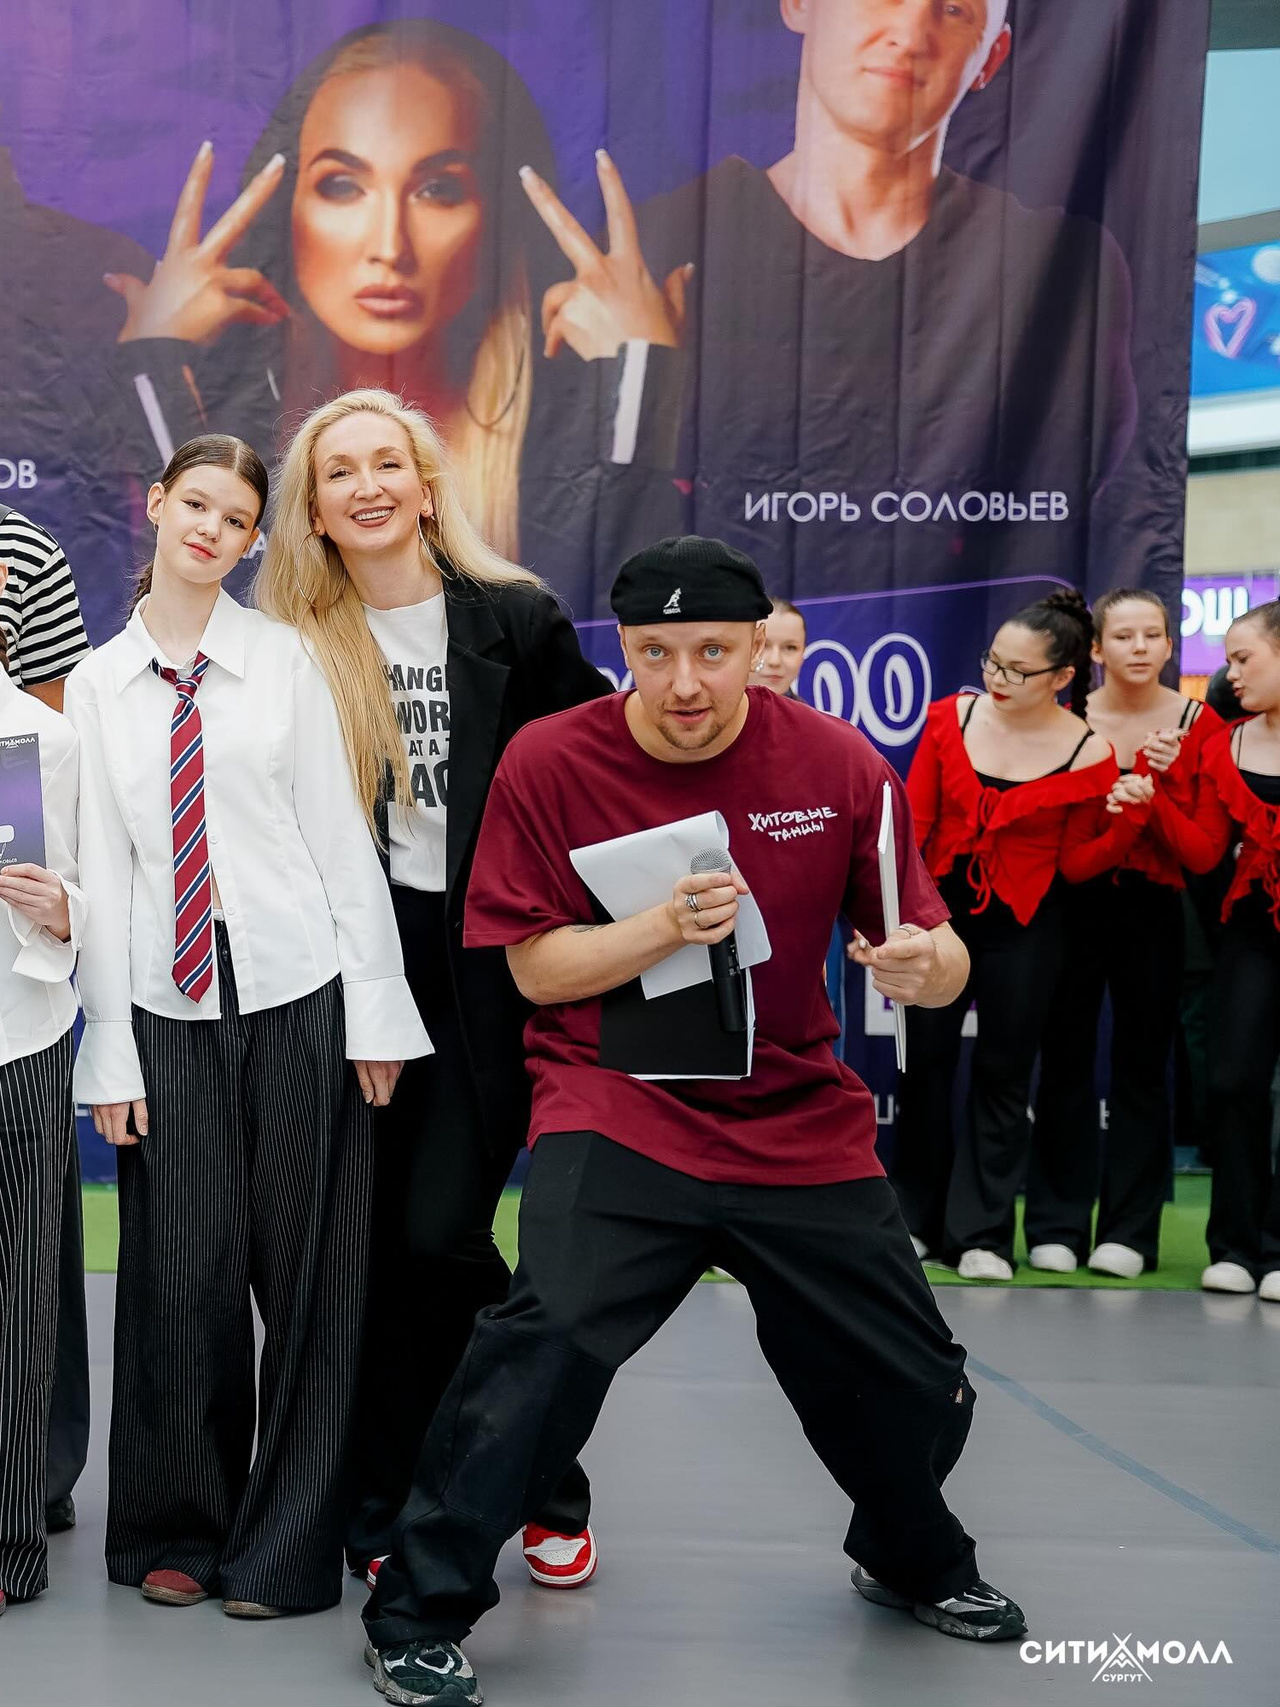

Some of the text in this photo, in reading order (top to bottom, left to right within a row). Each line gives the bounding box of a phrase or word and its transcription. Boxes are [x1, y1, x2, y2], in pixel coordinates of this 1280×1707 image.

[745, 490, 1069, 523] ИГОРЬ СОЛОВЬЕВ
[747, 806, 838, 832] ХИТОВЫЕ
[767, 820, 824, 842] ТАНЦЫ
